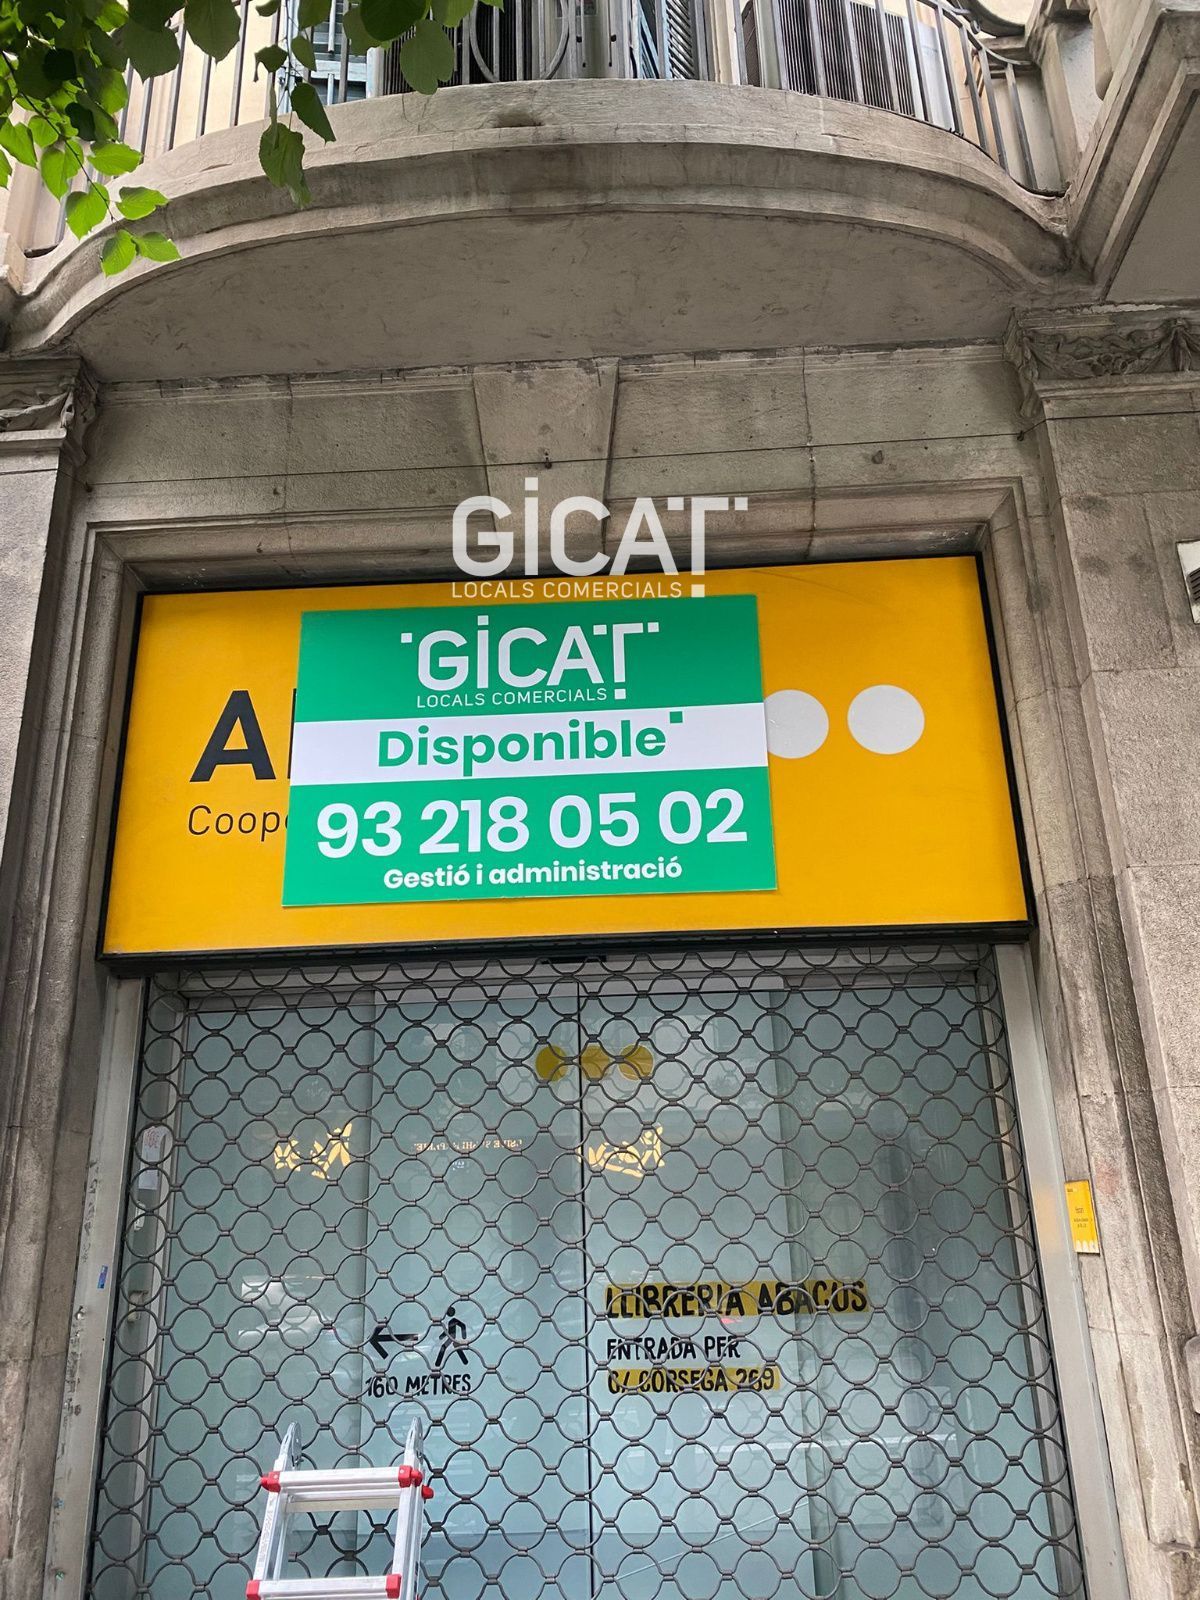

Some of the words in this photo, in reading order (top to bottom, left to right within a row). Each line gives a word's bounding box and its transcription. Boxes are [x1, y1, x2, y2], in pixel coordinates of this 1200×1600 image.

[416, 692, 485, 708] LOCALS
[491, 687, 607, 706] COMERCIALS
[378, 718, 667, 777] Disponible
[188, 804, 289, 843] Coop
[316, 801, 403, 859] 93
[419, 796, 530, 855] 218
[548, 791, 640, 849] 05
[657, 788, 748, 846] 02
[383, 863, 471, 890] Gestió
[475, 863, 484, 886] i
[488, 856, 683, 887] administració
[605, 1283, 745, 1319] LLIBRERIA
[757, 1280, 868, 1317] ABACUS
[606, 1336, 697, 1361] ENTRADA
[704, 1334, 742, 1359] PER
[364, 1375, 399, 1398] 160
[405, 1373, 472, 1397] METRES
[638, 1368, 729, 1393] CORSEGA
